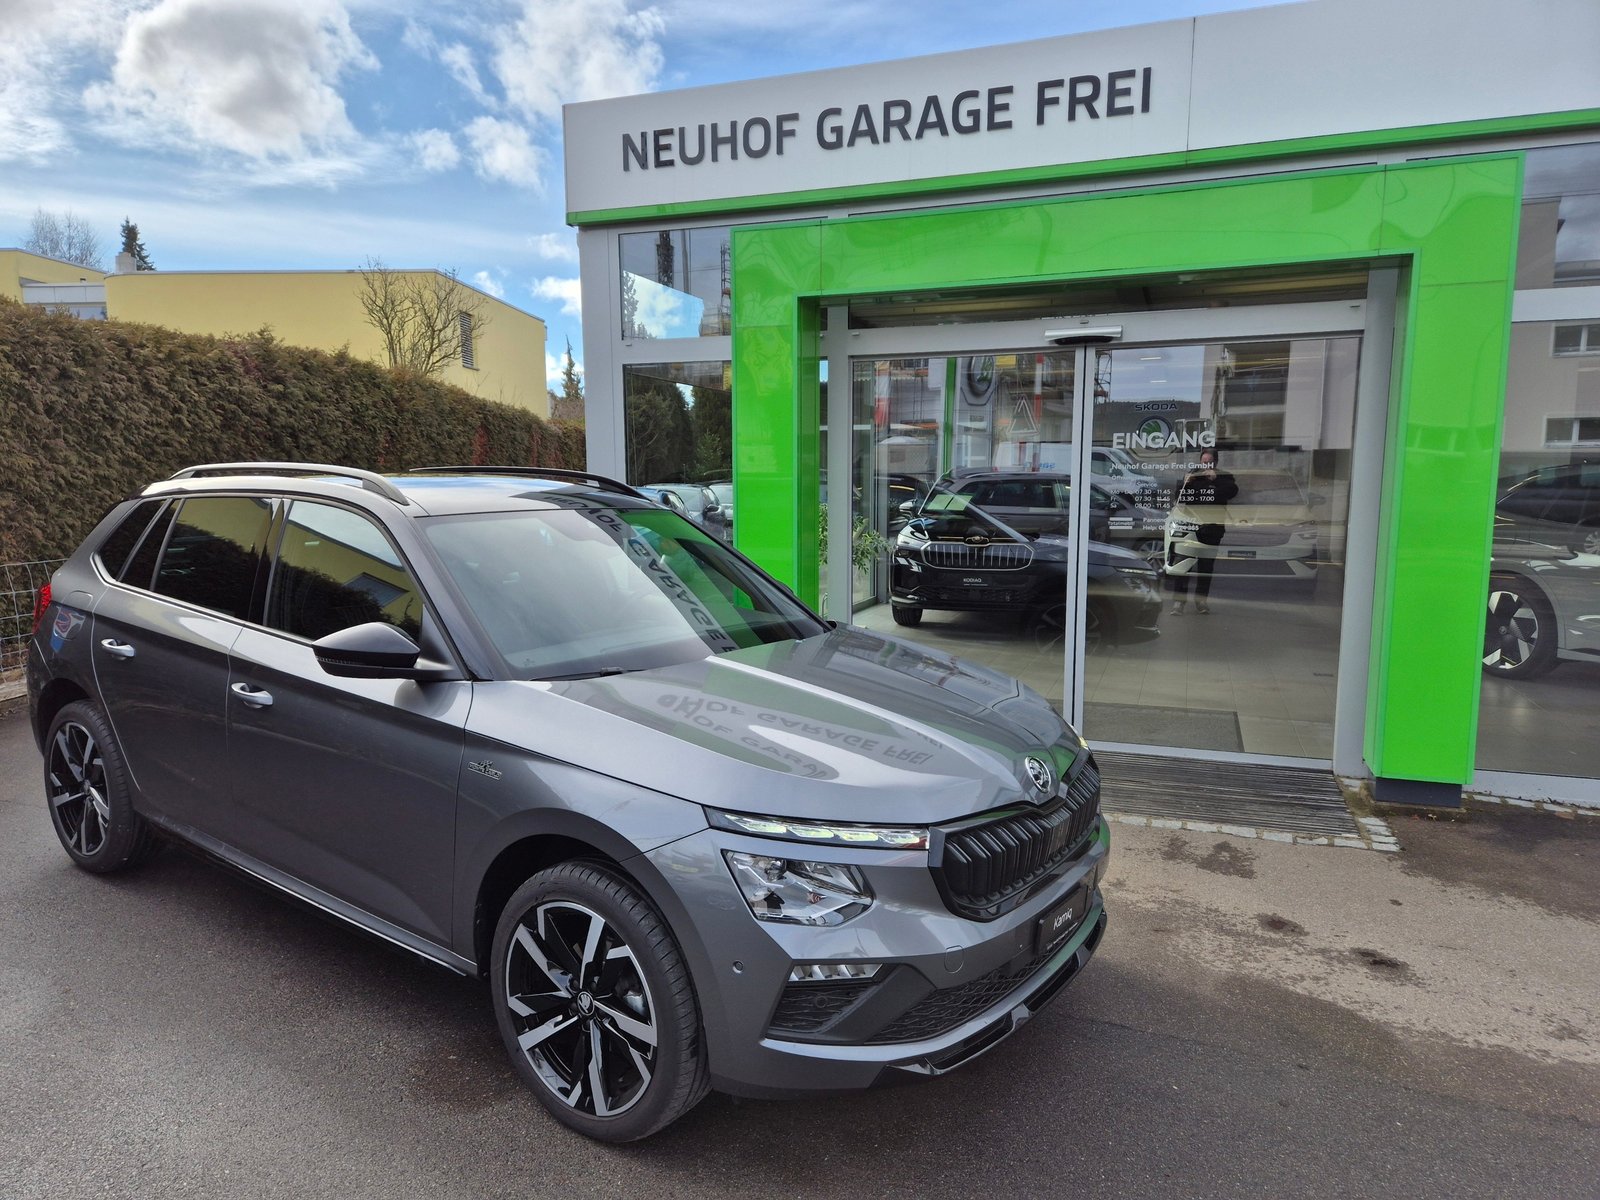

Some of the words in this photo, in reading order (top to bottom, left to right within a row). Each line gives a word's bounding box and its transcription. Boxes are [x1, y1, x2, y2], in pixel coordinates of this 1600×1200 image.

[621, 112, 800, 173] NEUHOF
[815, 85, 1015, 151] GARAGE
[1035, 66, 1153, 127] FREI
[1112, 430, 1216, 449] EINGANG
